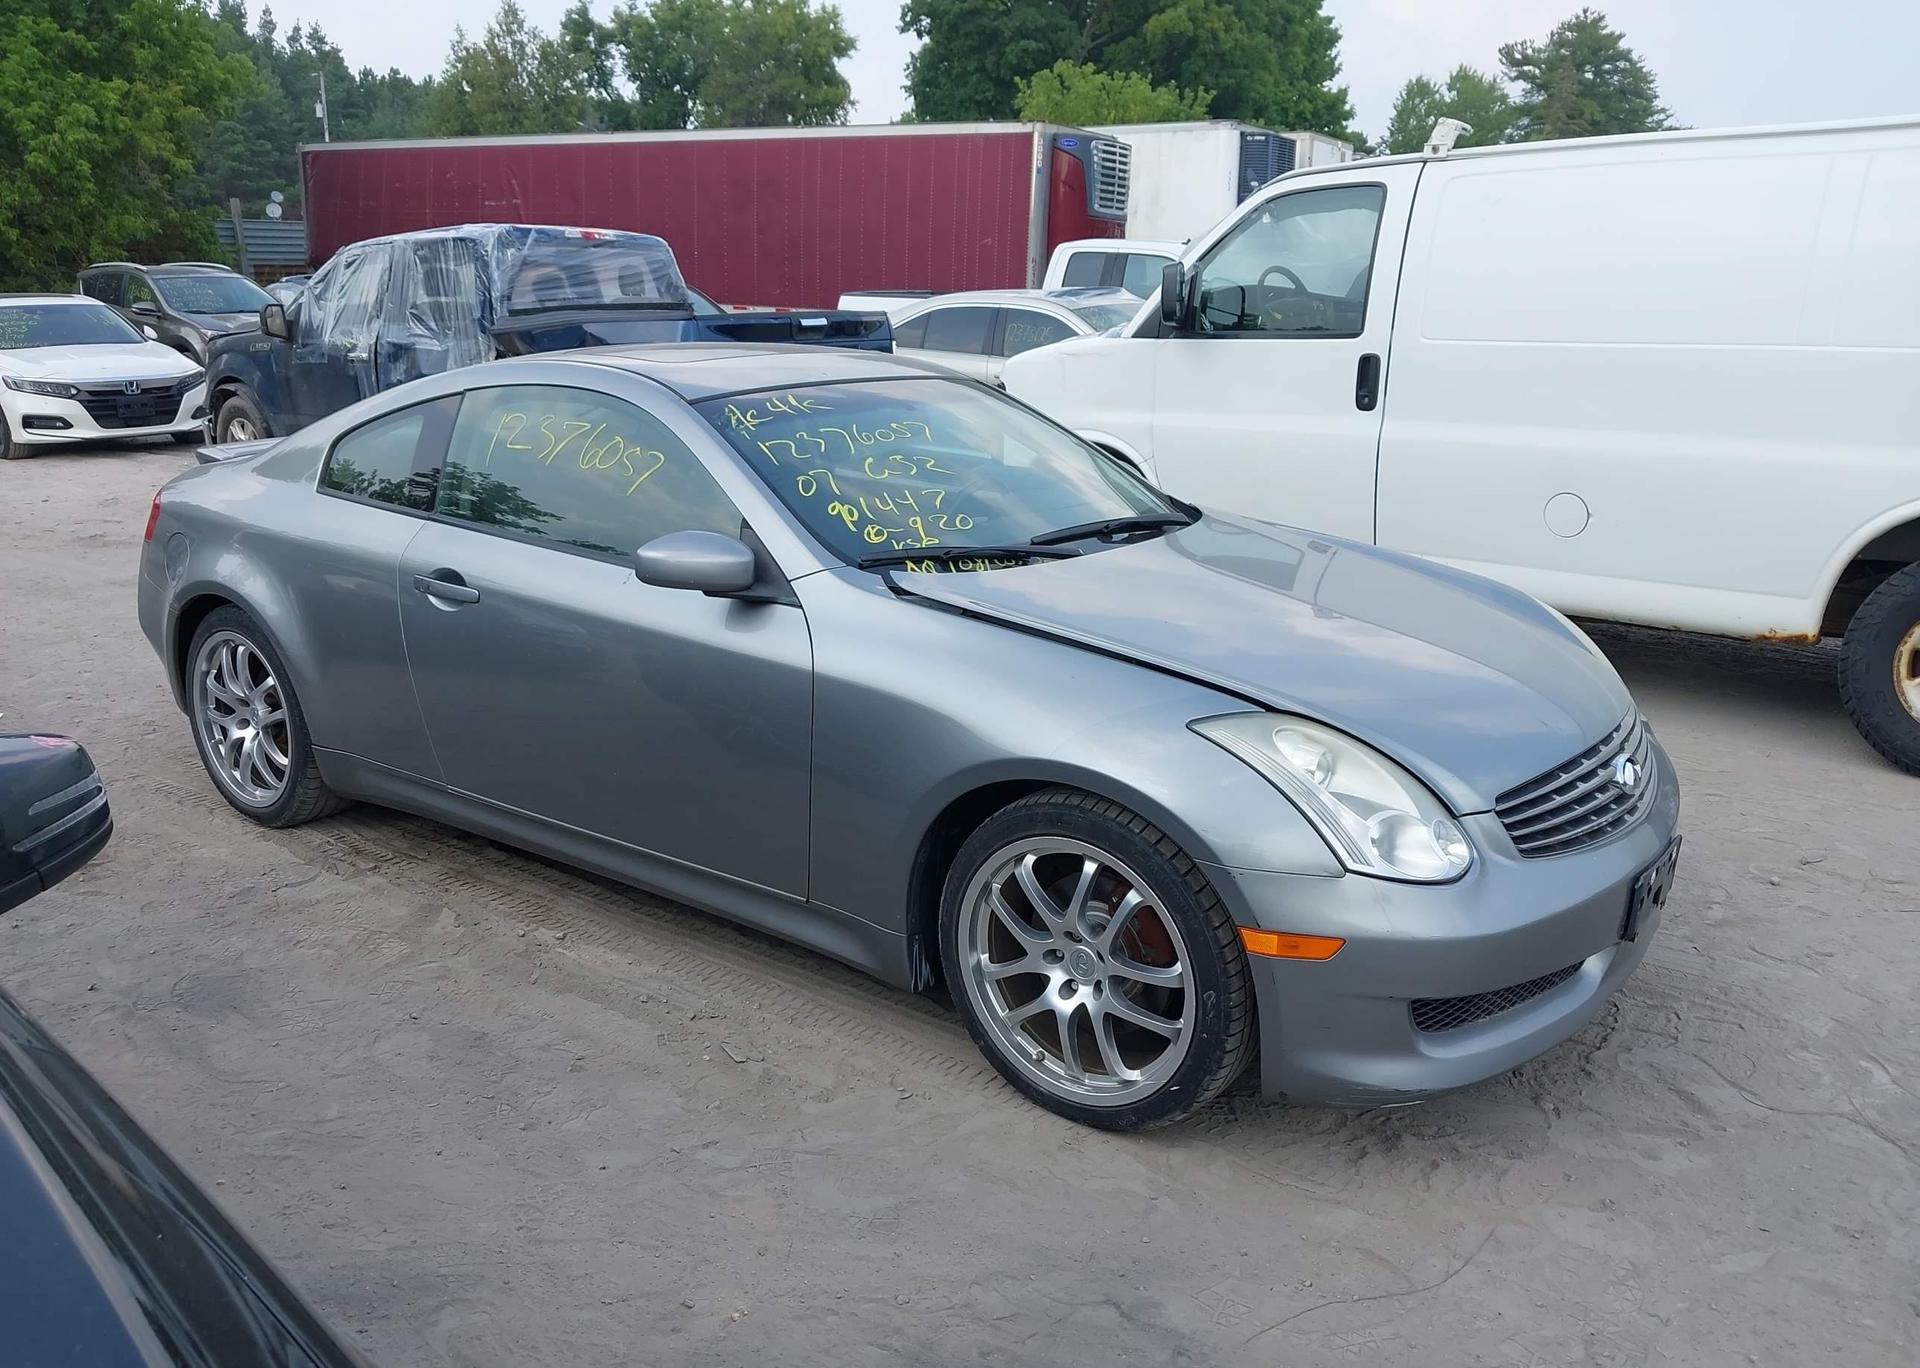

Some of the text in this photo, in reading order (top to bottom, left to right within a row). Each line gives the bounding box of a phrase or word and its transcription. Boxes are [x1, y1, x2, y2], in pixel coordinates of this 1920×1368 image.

[485, 412, 665, 497] 12376057
[757, 421, 933, 466] 12376057
[796, 469, 841, 497] 07
